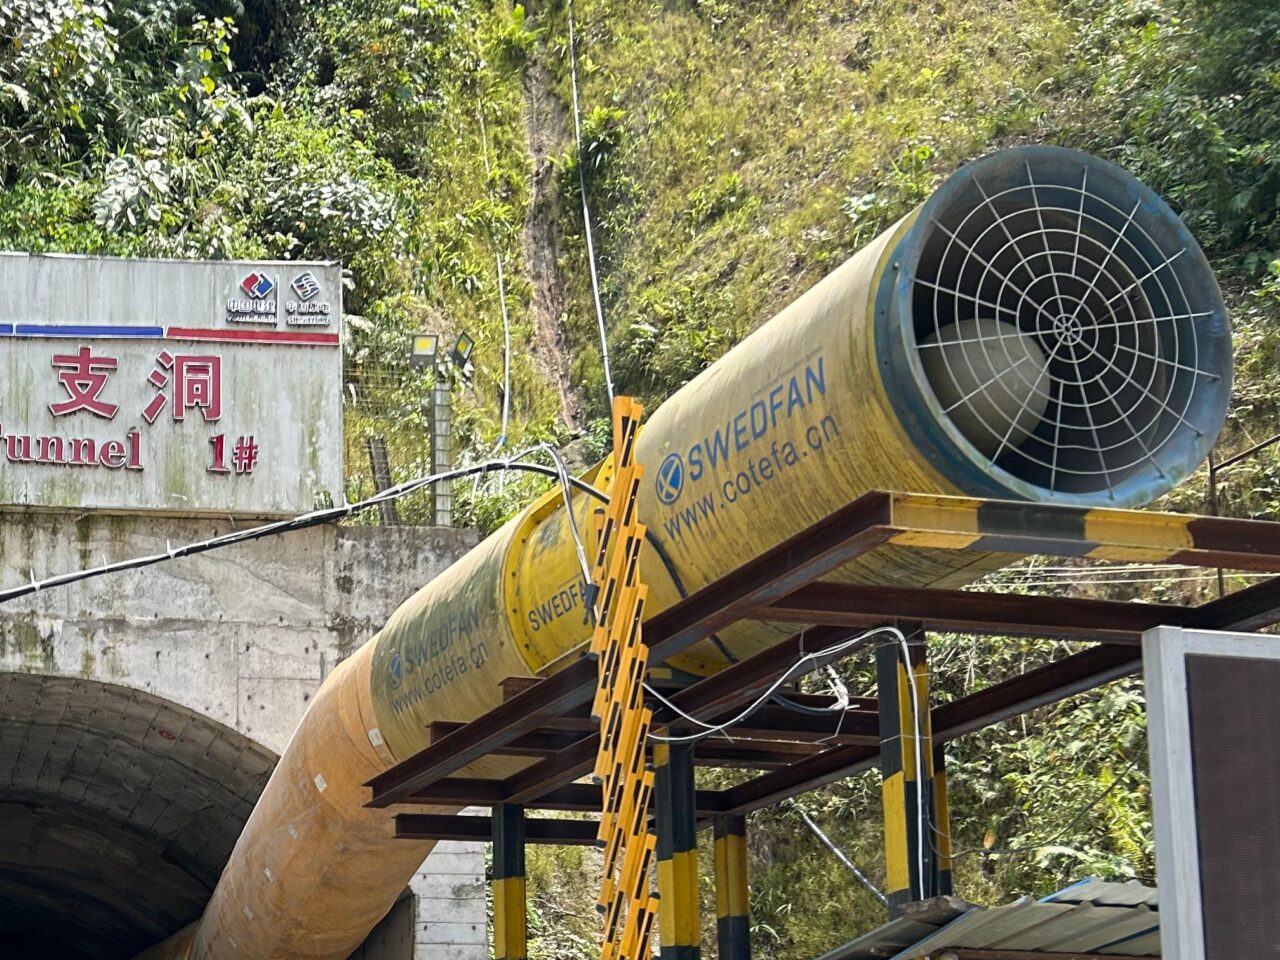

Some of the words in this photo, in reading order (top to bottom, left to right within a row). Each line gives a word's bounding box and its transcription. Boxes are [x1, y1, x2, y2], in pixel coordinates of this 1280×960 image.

[206, 435, 259, 474] 1#
[688, 357, 826, 481] SWEDFAN
[664, 415, 839, 540] www.cotefa.cn
[405, 606, 480, 675] SWEDFAN
[528, 580, 587, 631] SWEDFA
[391, 642, 488, 715] www.cotefa.cn
